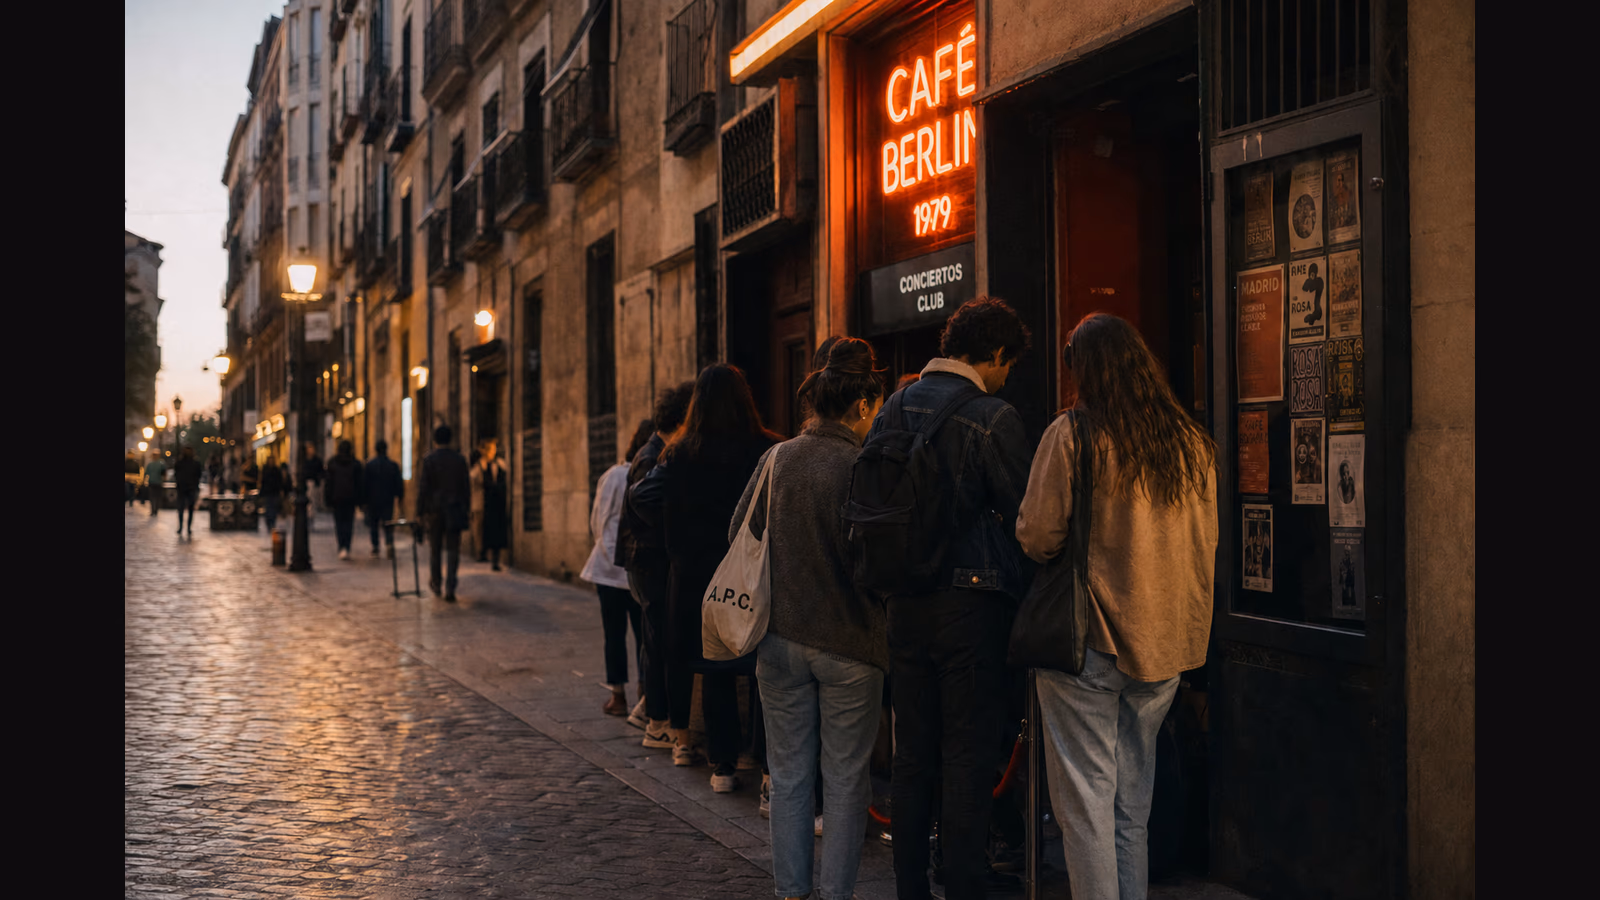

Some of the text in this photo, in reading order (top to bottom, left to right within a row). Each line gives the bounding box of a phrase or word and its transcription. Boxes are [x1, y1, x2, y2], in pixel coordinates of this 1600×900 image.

[887, 24, 976, 123] CAFÉ
[883, 109, 976, 194] BERLIN
[913, 195, 952, 236] 1979
[899, 263, 963, 293] CONCIERTOS
[1241, 277, 1279, 296] MADRID
[917, 291, 945, 312] CLUB
[1291, 300, 1312, 315] ROSA
[706, 586, 753, 612] A.P.C.
